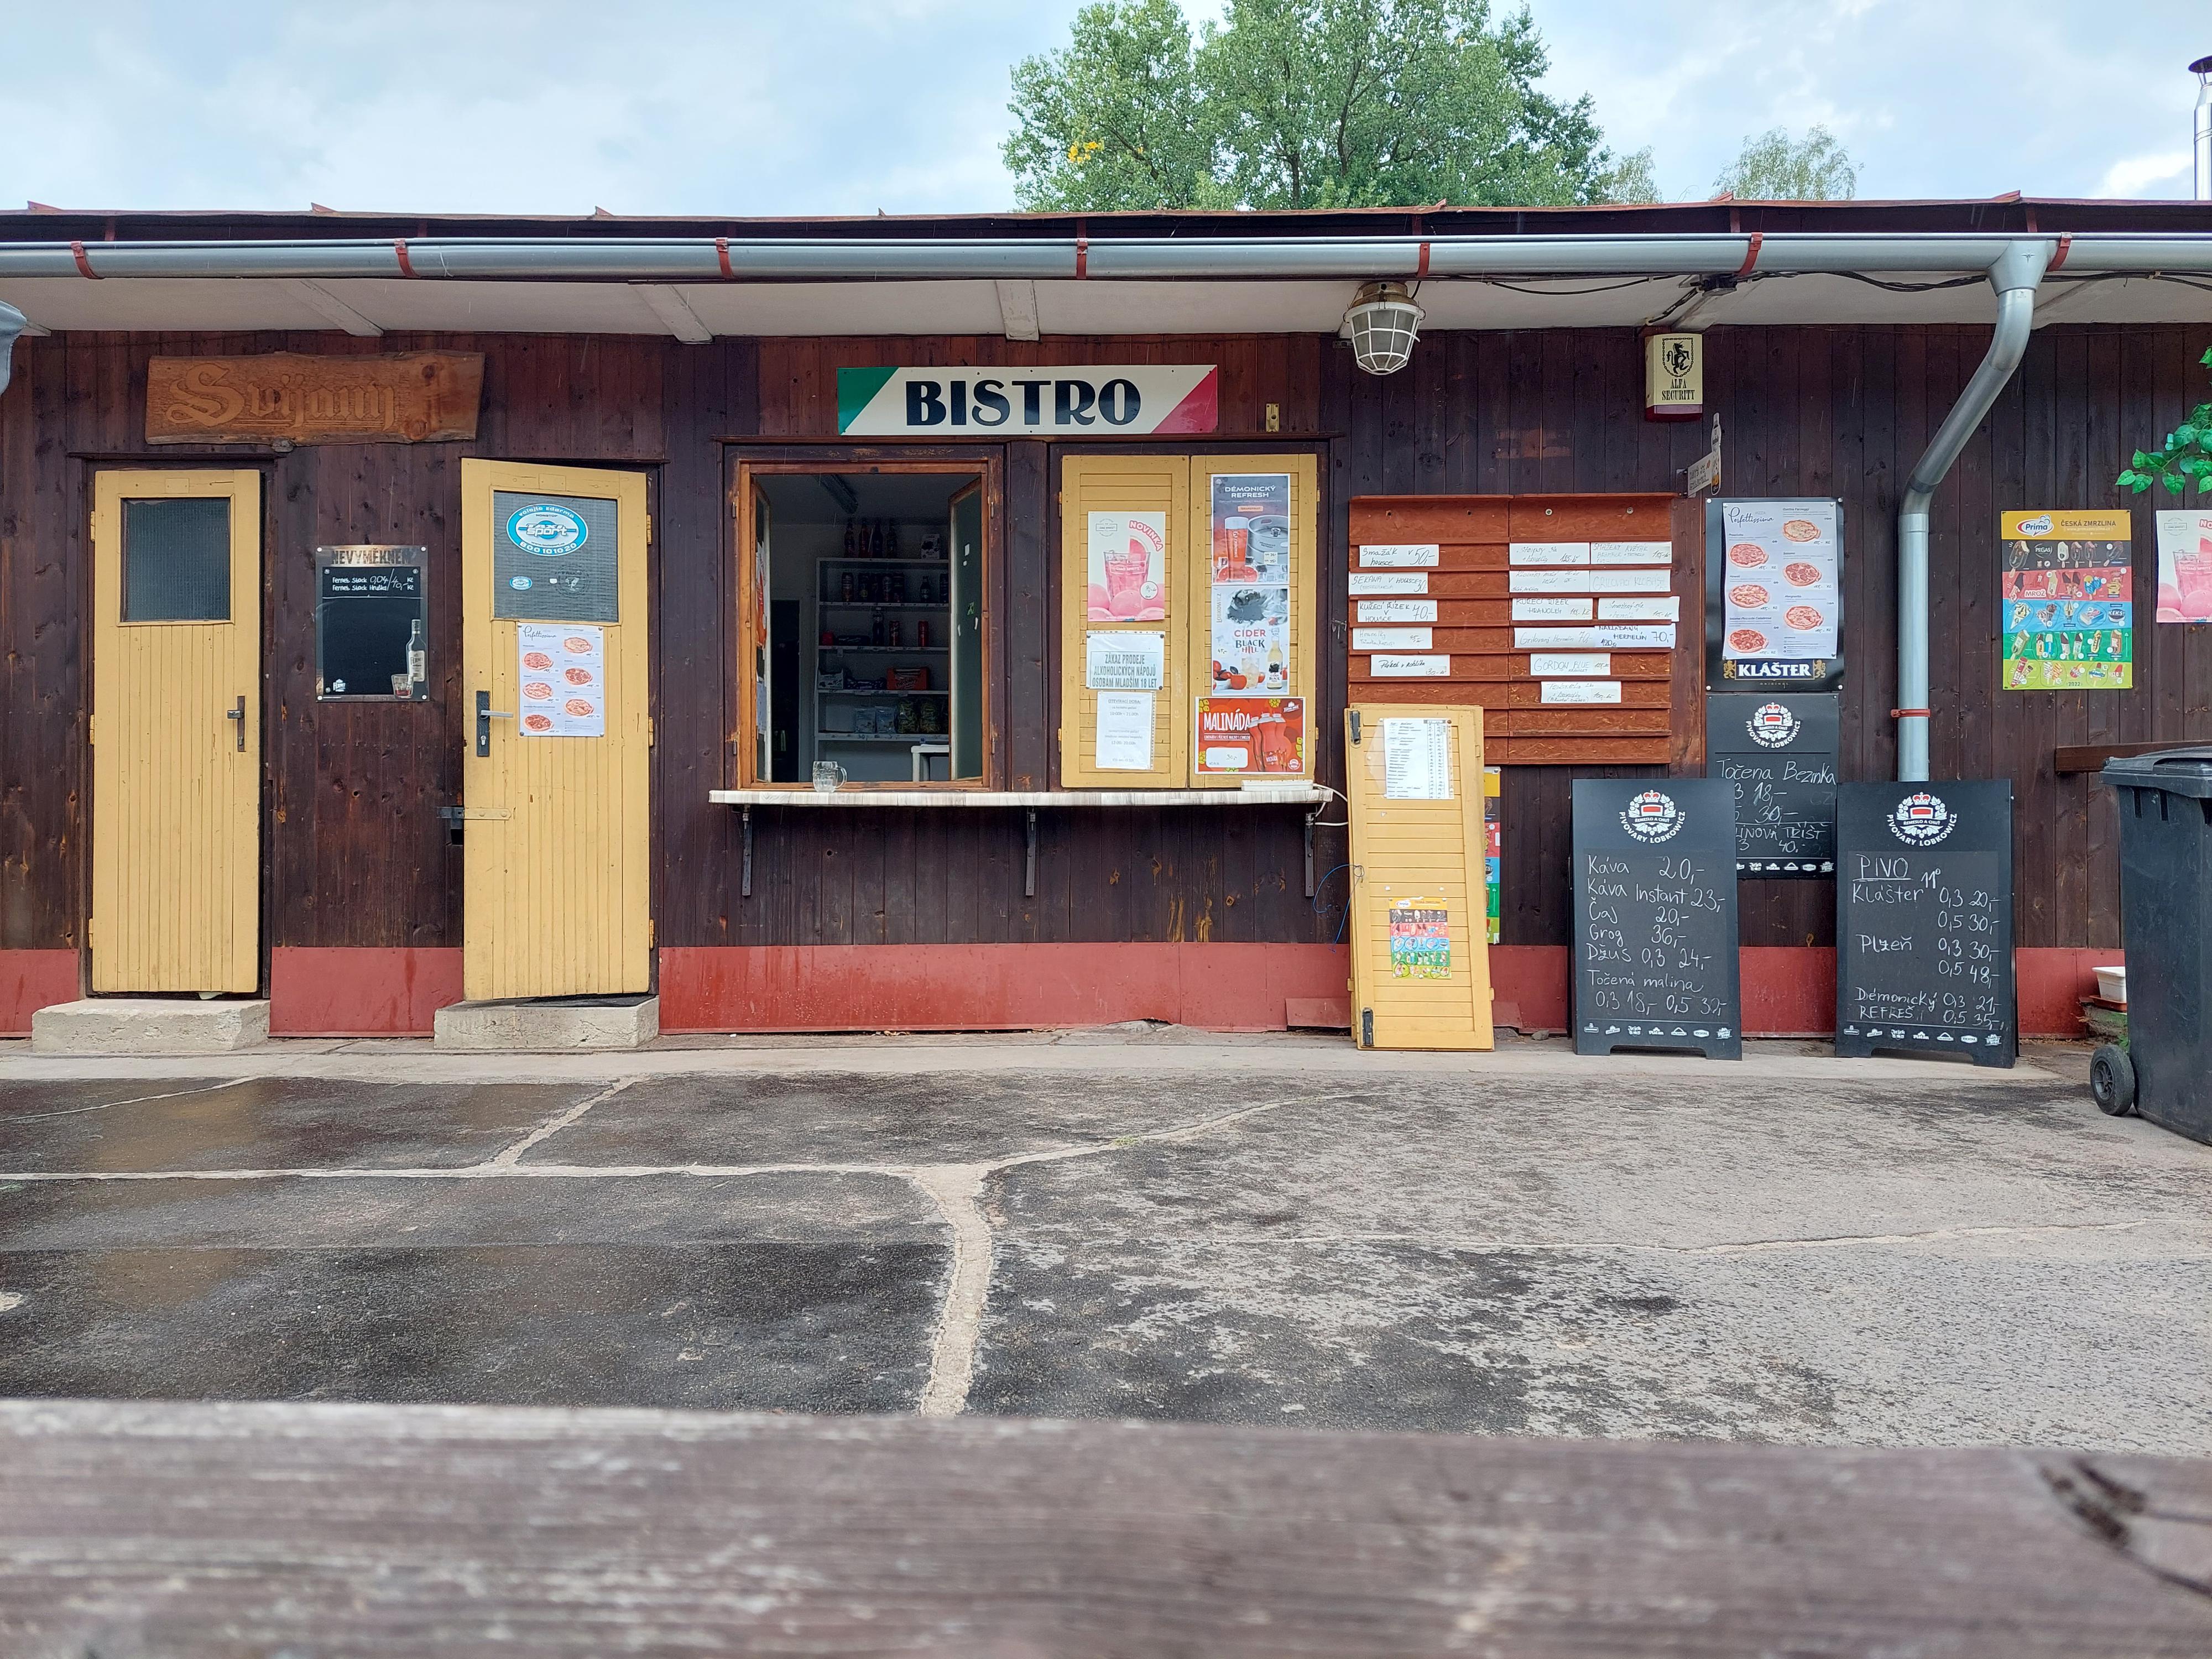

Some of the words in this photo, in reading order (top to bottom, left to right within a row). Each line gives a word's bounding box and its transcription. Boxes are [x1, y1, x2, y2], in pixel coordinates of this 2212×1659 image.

[1662, 390, 1695, 400] SECURITY
[1671, 379, 1687, 389] ALFA
[905, 379, 1141, 426] BISTRO
[1129, 520, 1163, 551] NOVINKA
[1370, 557, 1394, 566] housce
[1235, 639, 1265, 649] BLACK
[1241, 646, 1259, 654] HILL
[1094, 664, 1134, 676] ALKOHOLICKÝCH
[1136, 664, 1155, 676] NÁPOJŮ
[1105, 653, 1121, 664] ZÁKAZ
[1122, 654, 1145, 664] PRODEJE
[1738, 662, 1812, 676] KLÁŠTER
[1115, 676, 1139, 687] MLADŠÍM
[1141, 679, 1146, 688] 18
[1148, 679, 1157, 688] LET
[1204, 708, 1250, 732] MALINÁDA
[1746, 721, 1770, 748] PIVOVARY
[1771, 721, 1801, 748] LOBKOWICZ
[1619, 812, 1648, 843] PIVOVARY
[1650, 811, 1686, 843] LOBKOWICZ
[1886, 814, 1917, 846] PIVOVARY
[1919, 813, 1958, 847] LOBKOWICZ
[1588, 854, 1630, 874] Káva
[1659, 856, 1705, 885] 20,-
[1855, 854, 1909, 879] PIVO
[1587, 878, 1628, 897] Káva
[1636, 883, 1688, 904] Instant
[1691, 888, 1726, 912] 23,-
[1853, 883, 1924, 904] Klášter
[1939, 886, 1964, 908] 0,3
[1655, 906, 1690, 926] 20,-
[1938, 910, 1965, 932] 0,5
[1968, 914, 2001, 935] 30,-
[1589, 923, 1624, 947] Grog
[1651, 924, 1687, 949] 36,-
[1855, 934, 1912, 953] Plzeň
[1938, 937, 1963, 957] 0,3
[1969, 941, 2002, 962] 30,-
[1586, 943, 1632, 962] Džus
[1641, 948, 1666, 968] 0,3
[1678, 948, 1712, 970] 24,-
[1586, 969, 1635, 986] Točená
[1644, 973, 1704, 993] malina
[1938, 959, 1965, 978] 0,5
[1969, 964, 2001, 989] 48,-
[1595, 990, 1620, 1010] 0,3
[1627, 990, 1658, 1015] 18,-
[1666, 994, 1692, 1014] 0,5
[1700, 997, 1728, 1016] 30,-
[1943, 992, 1965, 1008] 0,3
[1943, 1009, 1968, 1024] 0,5
